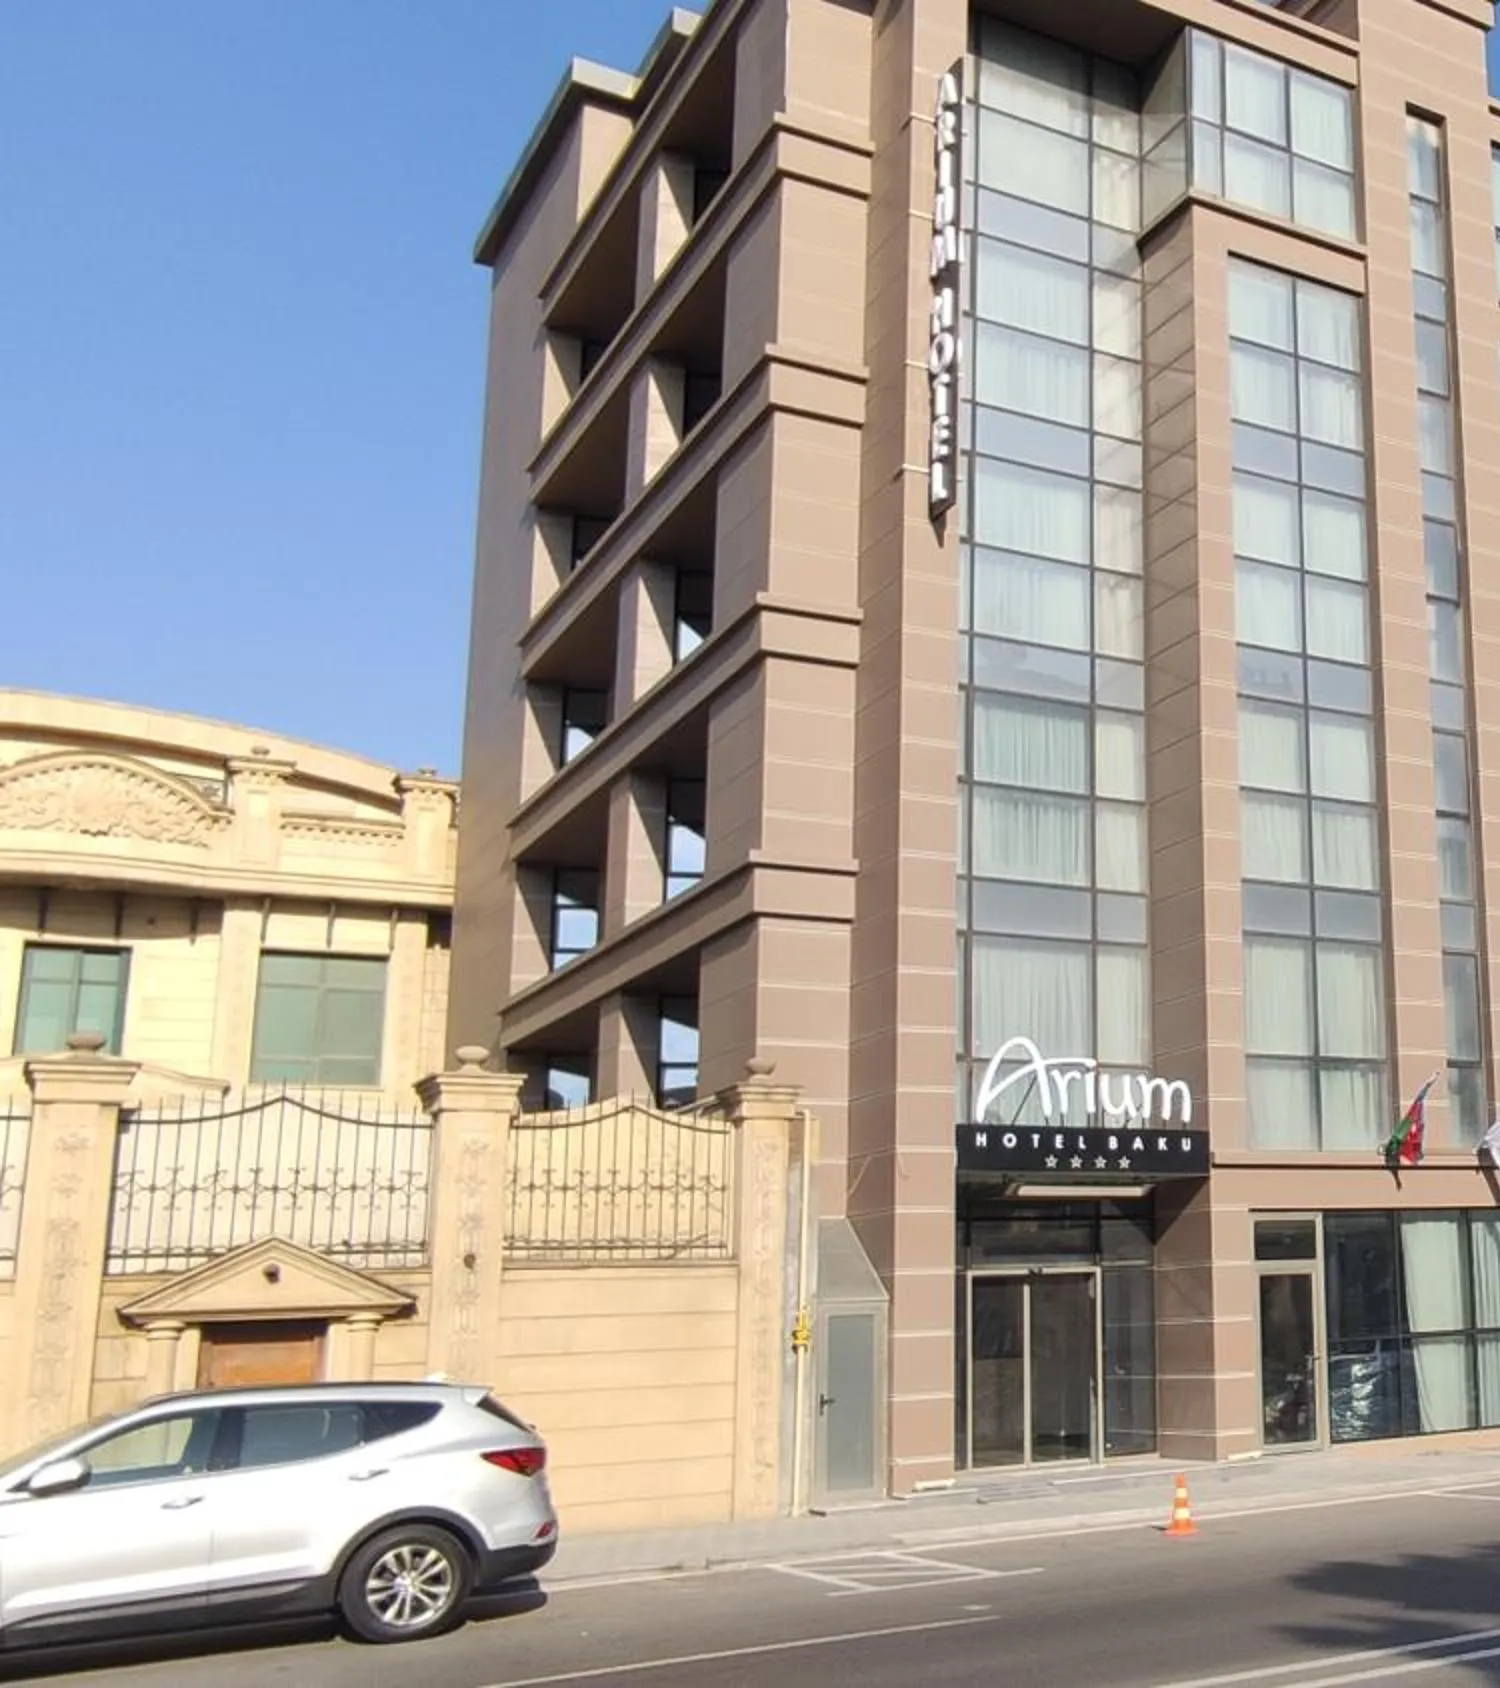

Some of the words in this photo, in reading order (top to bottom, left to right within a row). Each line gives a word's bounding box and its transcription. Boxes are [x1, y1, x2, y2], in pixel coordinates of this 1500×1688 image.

[930, 72, 958, 277] ARIUM
[928, 287, 955, 503] HOTEL
[975, 1036, 1192, 1124] Arium
[975, 1133, 1087, 1149] HOTEL
[1108, 1135, 1192, 1152] BAKU
